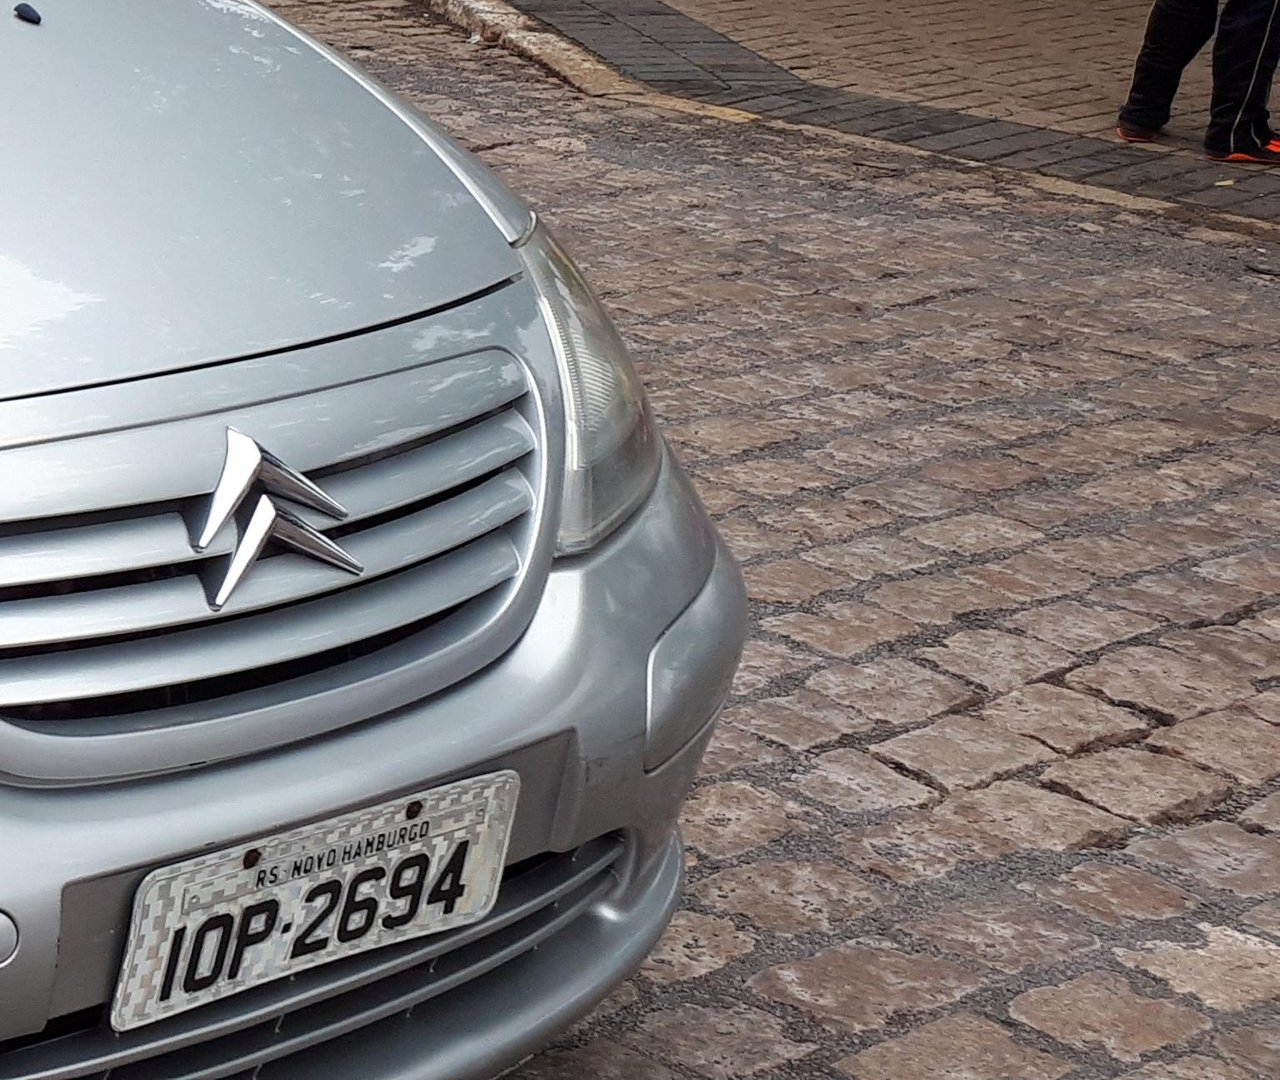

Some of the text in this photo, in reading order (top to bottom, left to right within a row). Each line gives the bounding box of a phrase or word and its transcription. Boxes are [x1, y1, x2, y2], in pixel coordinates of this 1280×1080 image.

[255, 820, 430, 888] RS NOVO HAMBURGO
